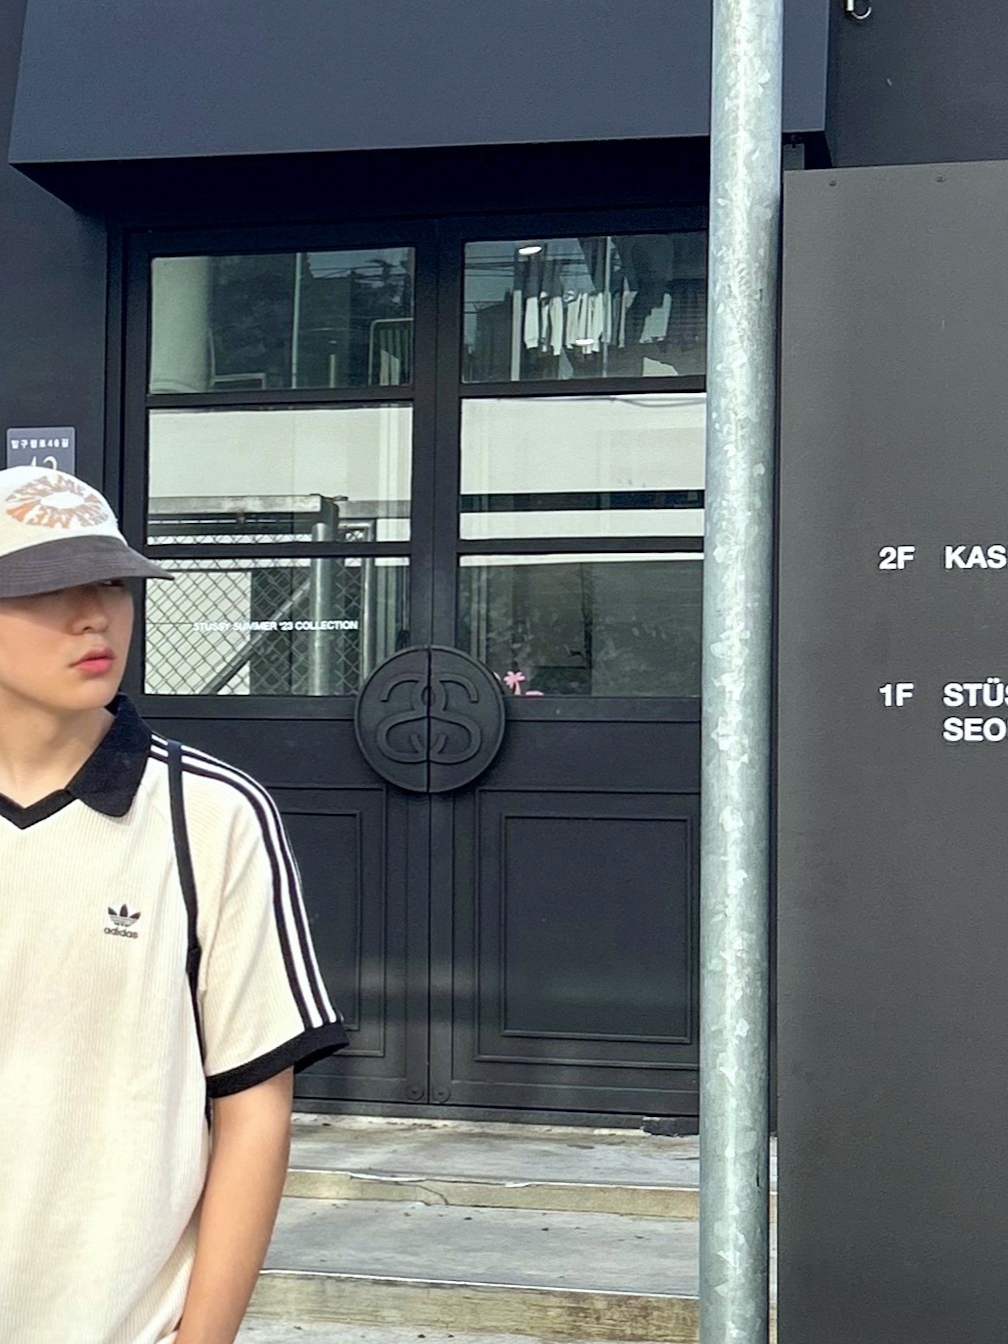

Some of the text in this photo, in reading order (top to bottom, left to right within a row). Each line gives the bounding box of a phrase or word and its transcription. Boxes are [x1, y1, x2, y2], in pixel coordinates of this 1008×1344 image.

[878, 545, 1007, 570] 2F KAS
[233, 620, 277, 632] SUMMER
[294, 619, 359, 631] COLLECTION
[878, 677, 1008, 707] 1F STÜ
[943, 716, 1007, 742] SEO
[103, 926, 139, 939] adidas
